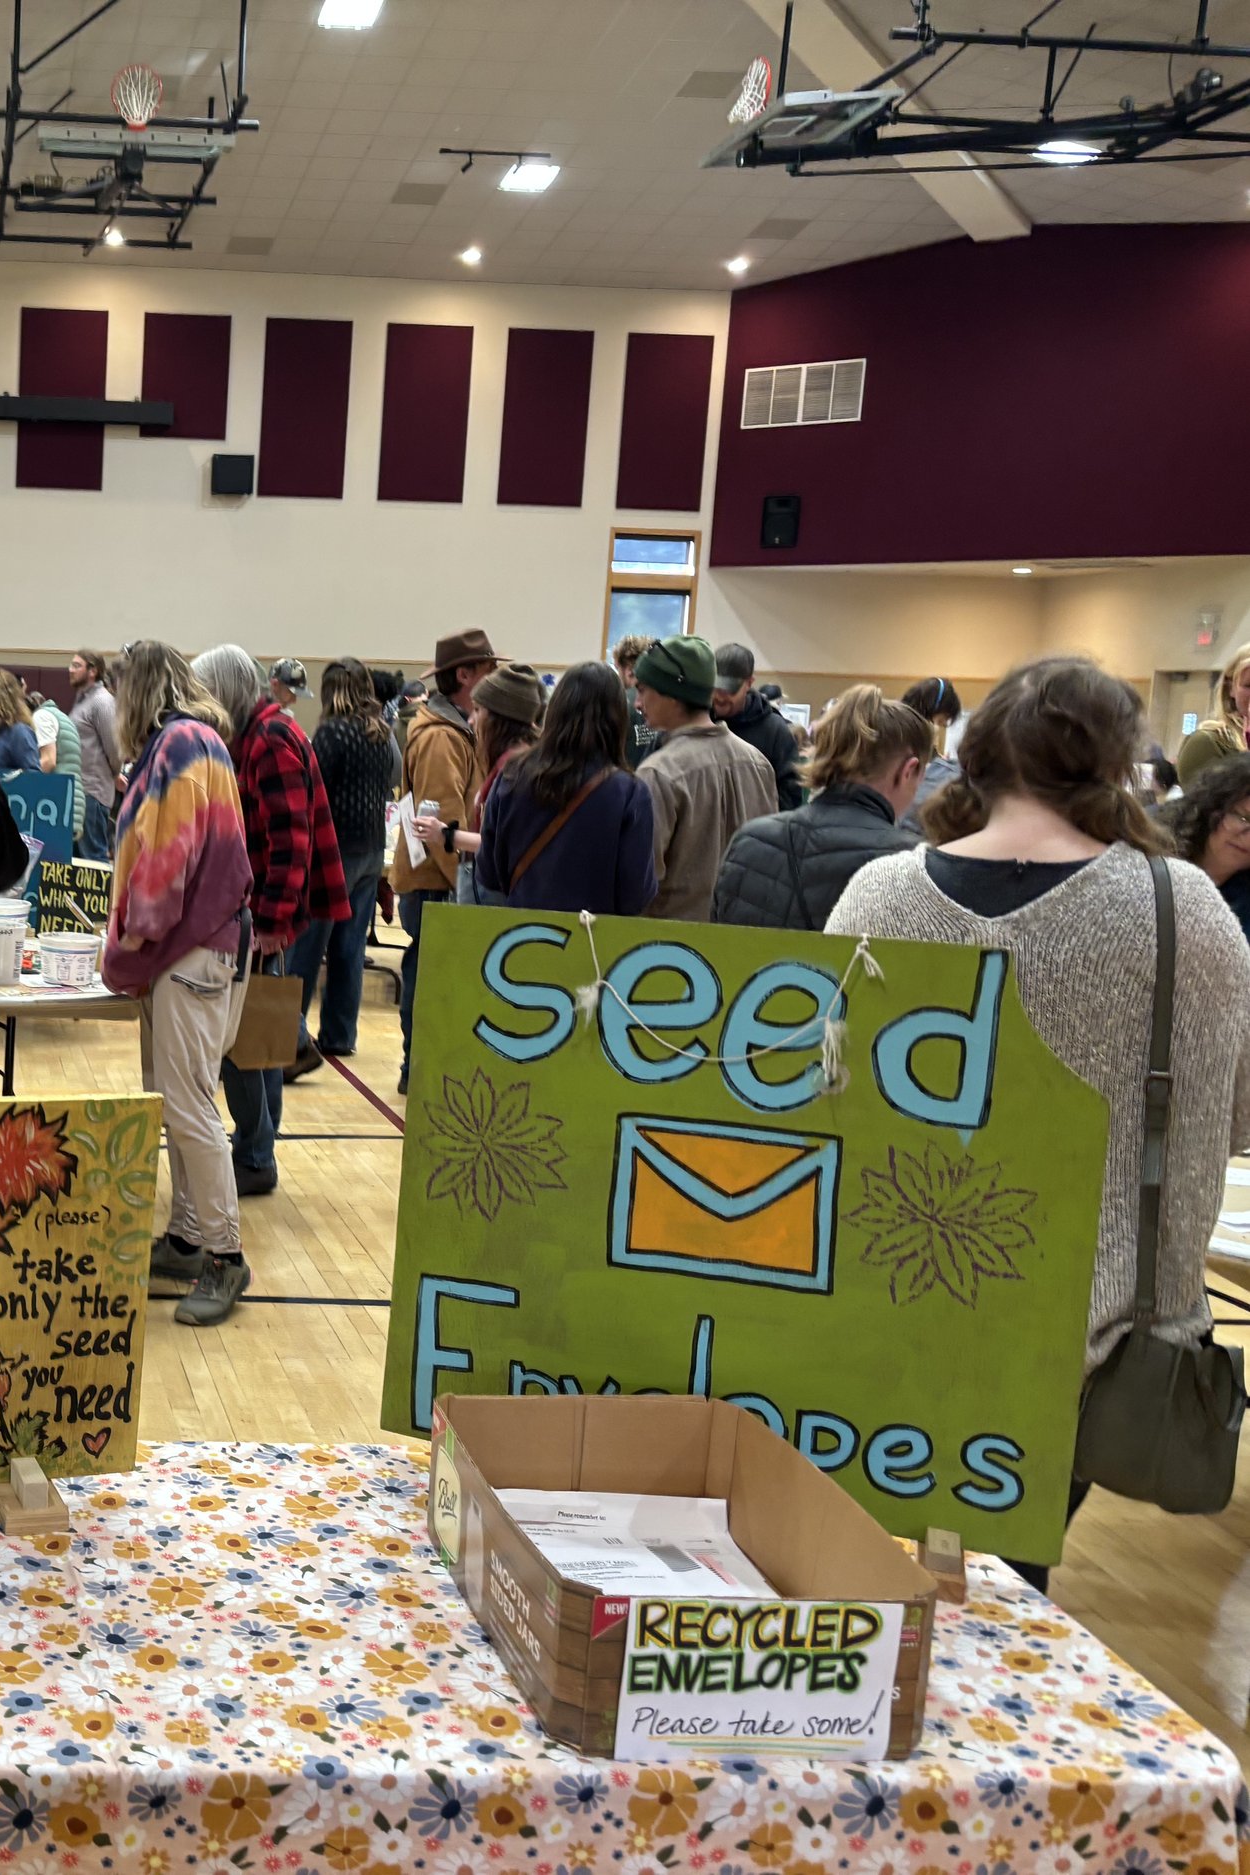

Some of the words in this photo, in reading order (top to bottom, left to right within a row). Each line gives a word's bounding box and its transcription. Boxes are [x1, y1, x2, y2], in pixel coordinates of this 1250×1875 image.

[40, 861, 74, 886] TAKE
[75, 868, 112, 892] ONLY
[39, 886, 78, 909] WHAT
[83, 893, 108, 915] YOU
[34, 1205, 111, 1239] (please)
[14, 1247, 97, 1285] take
[71, 1283, 130, 1320] the
[51, 1310, 137, 1361] seed
[22, 1362, 64, 1400] you
[54, 1361, 136, 1424] need
[491, 1549, 530, 1620] SMOOTH
[490, 1576, 515, 1625] SIDED
[516, 1613, 541, 1662] JARS
[636, 1600, 884, 1651] RECYCLED
[627, 1651, 868, 1694] ENVELOPES
[631, 1706, 720, 1736] Please
[729, 1709, 795, 1737] take
[802, 1690, 885, 1737] some!
